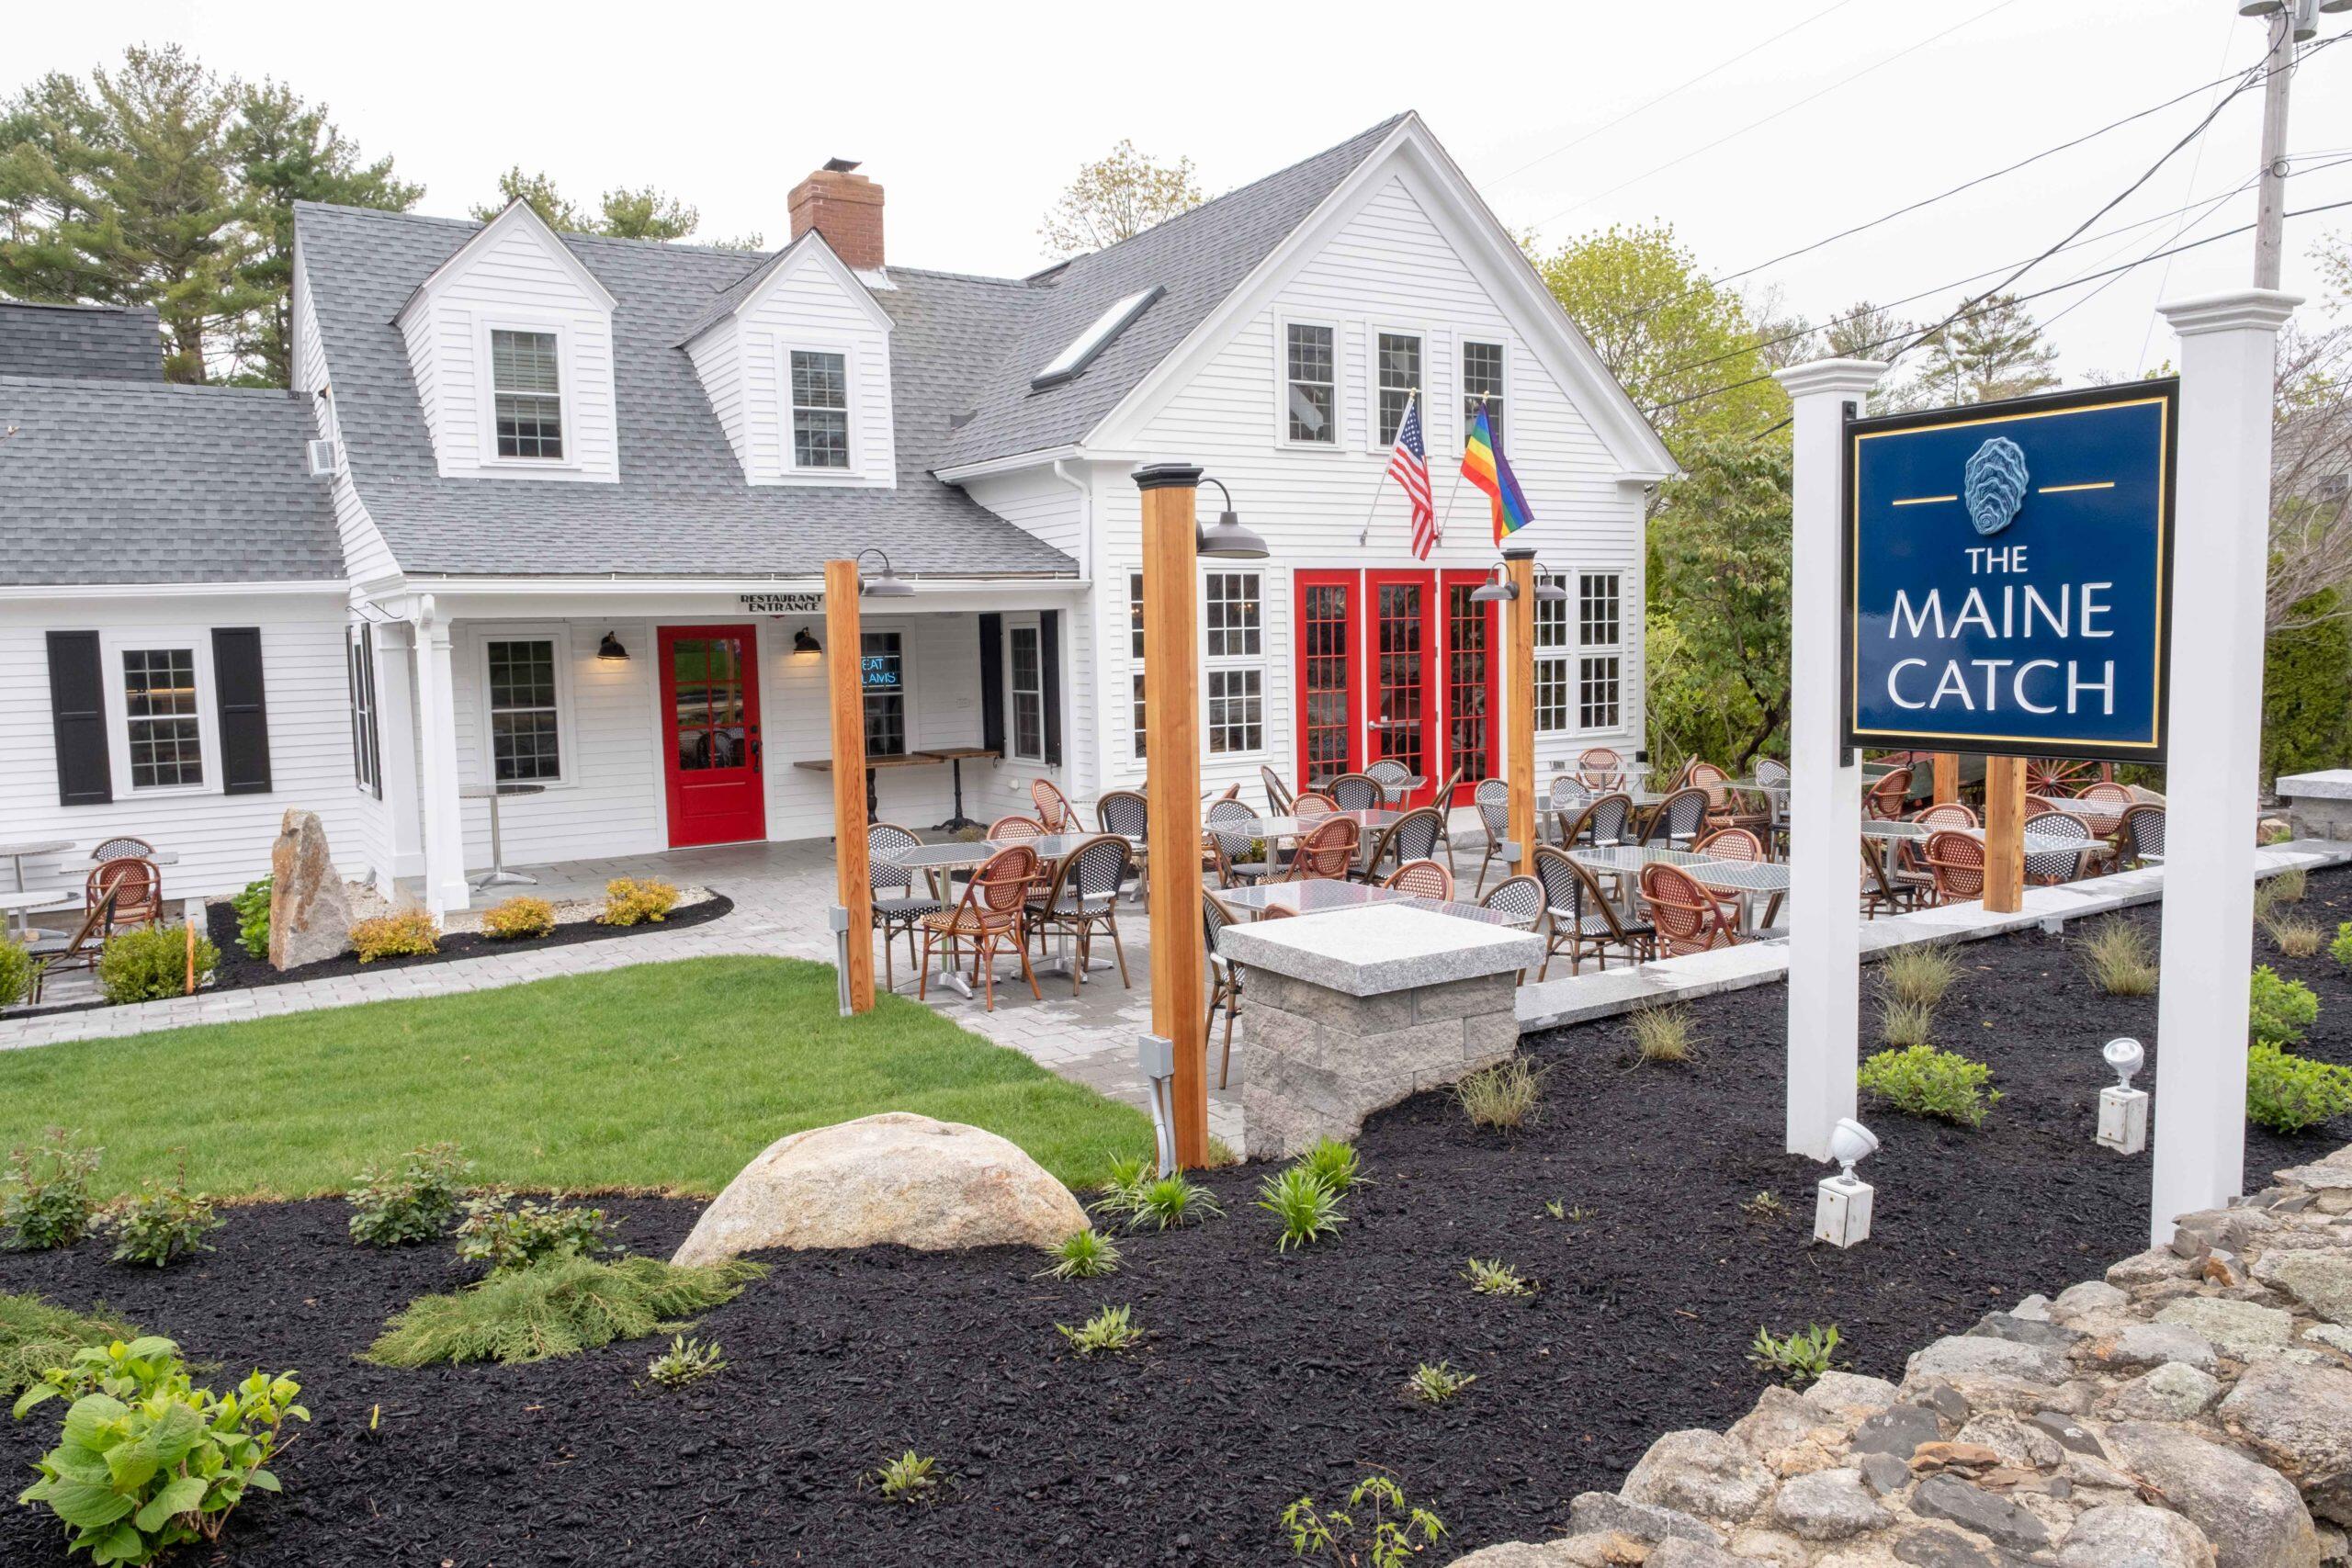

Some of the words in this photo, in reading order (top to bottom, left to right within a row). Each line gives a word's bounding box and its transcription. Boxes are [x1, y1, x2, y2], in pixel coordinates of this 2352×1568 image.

[1964, 545, 2029, 574] THE
[741, 594, 823, 603] RESTAURANT
[749, 603, 819, 612] ENTRANCE
[1888, 581, 2115, 639] MAINE
[862, 658, 884, 670] EAT
[861, 671, 896, 683] LAMS
[1887, 658, 2115, 715] CATCH
